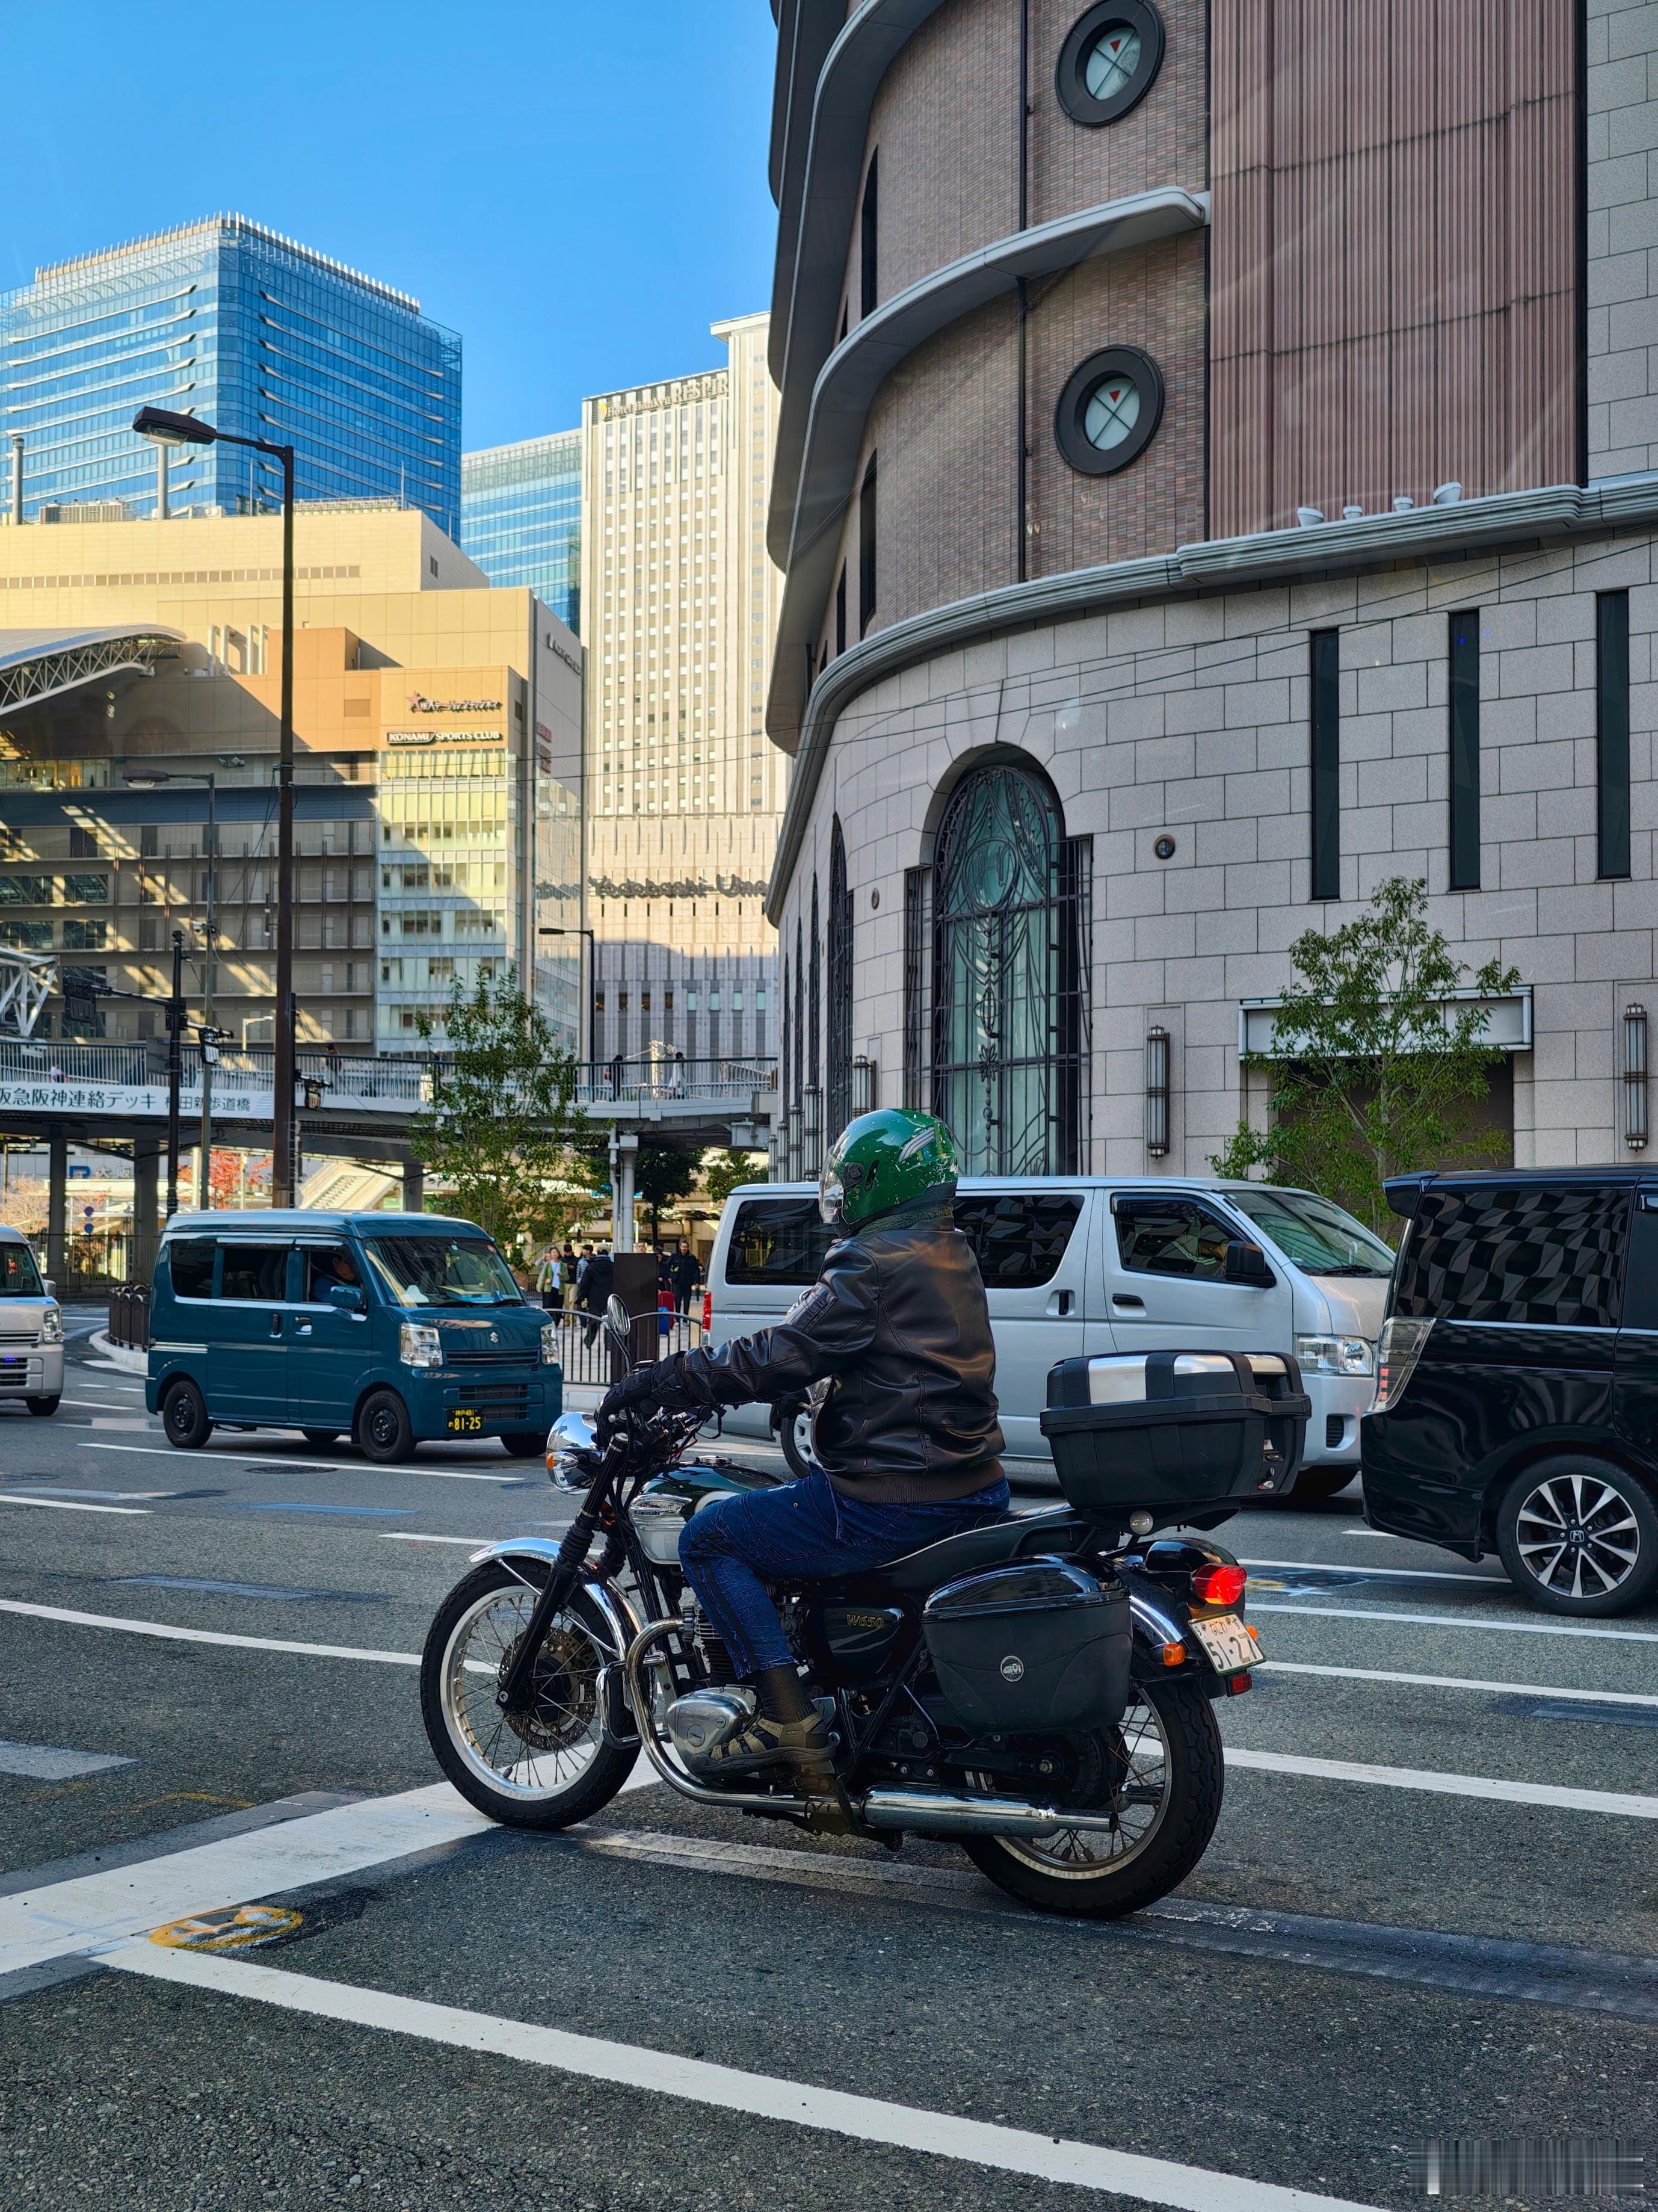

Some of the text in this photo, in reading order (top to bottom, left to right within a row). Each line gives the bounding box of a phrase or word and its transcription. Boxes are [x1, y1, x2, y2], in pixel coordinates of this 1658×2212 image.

[389, 731, 500, 741] KONAMI SPORTS CLUB
[454, 1416, 481, 1430] 81-25
[846, 1614, 884, 1628] W650
[1209, 1619, 1228, 1636] なにわ
[1206, 1632, 1257, 1669] 51-27
